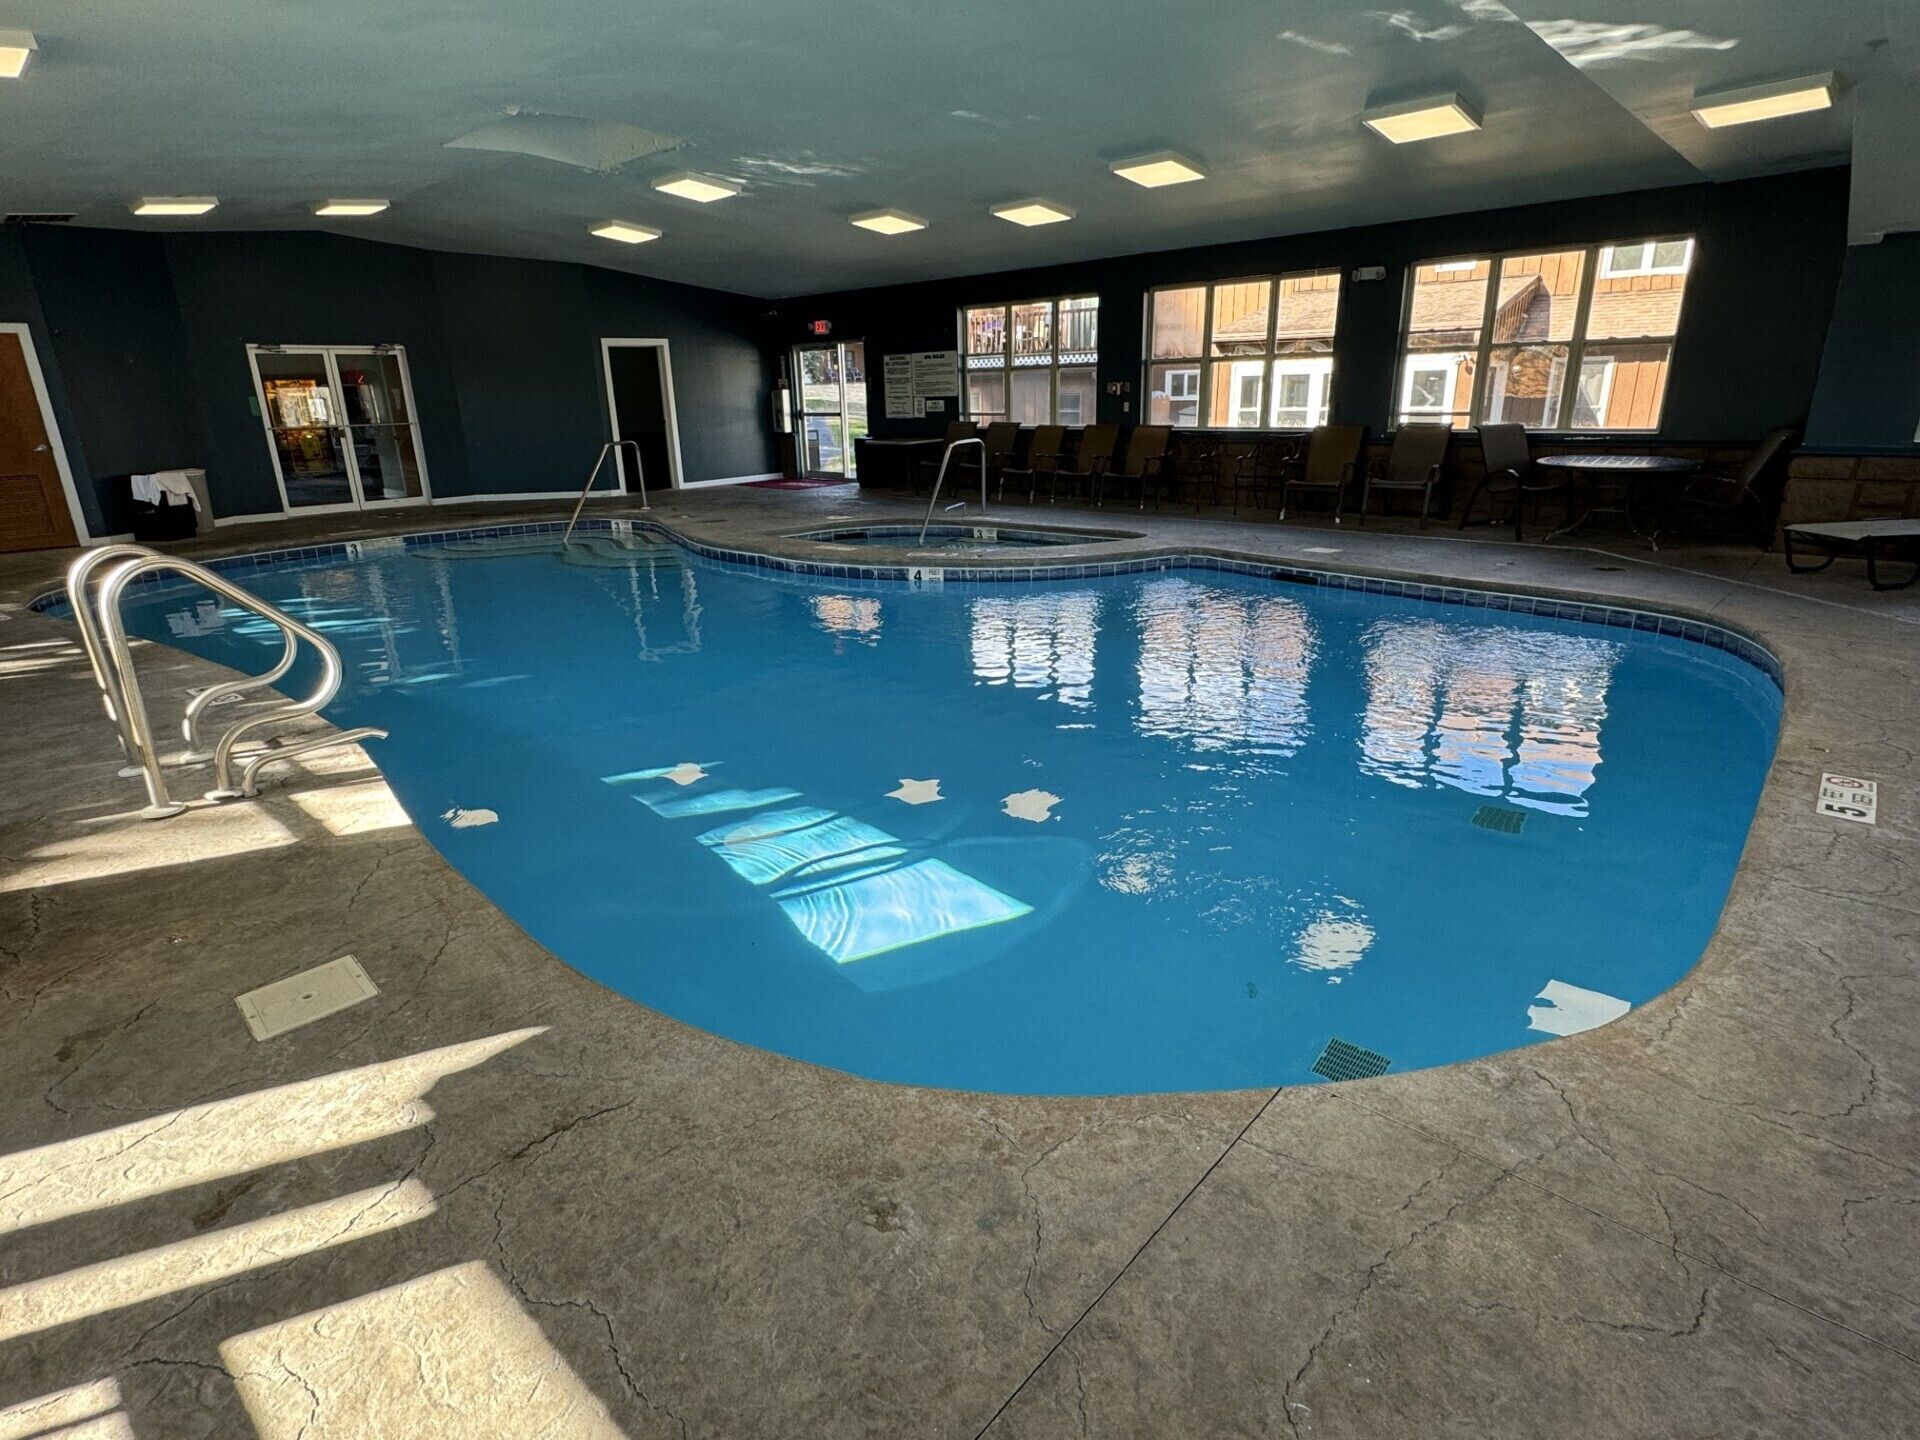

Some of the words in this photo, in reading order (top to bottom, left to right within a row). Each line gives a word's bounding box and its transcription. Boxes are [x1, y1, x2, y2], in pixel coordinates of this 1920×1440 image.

[977, 529, 983, 539] 3
[913, 569, 923, 581] 4
[1825, 803, 1867, 817] 5
